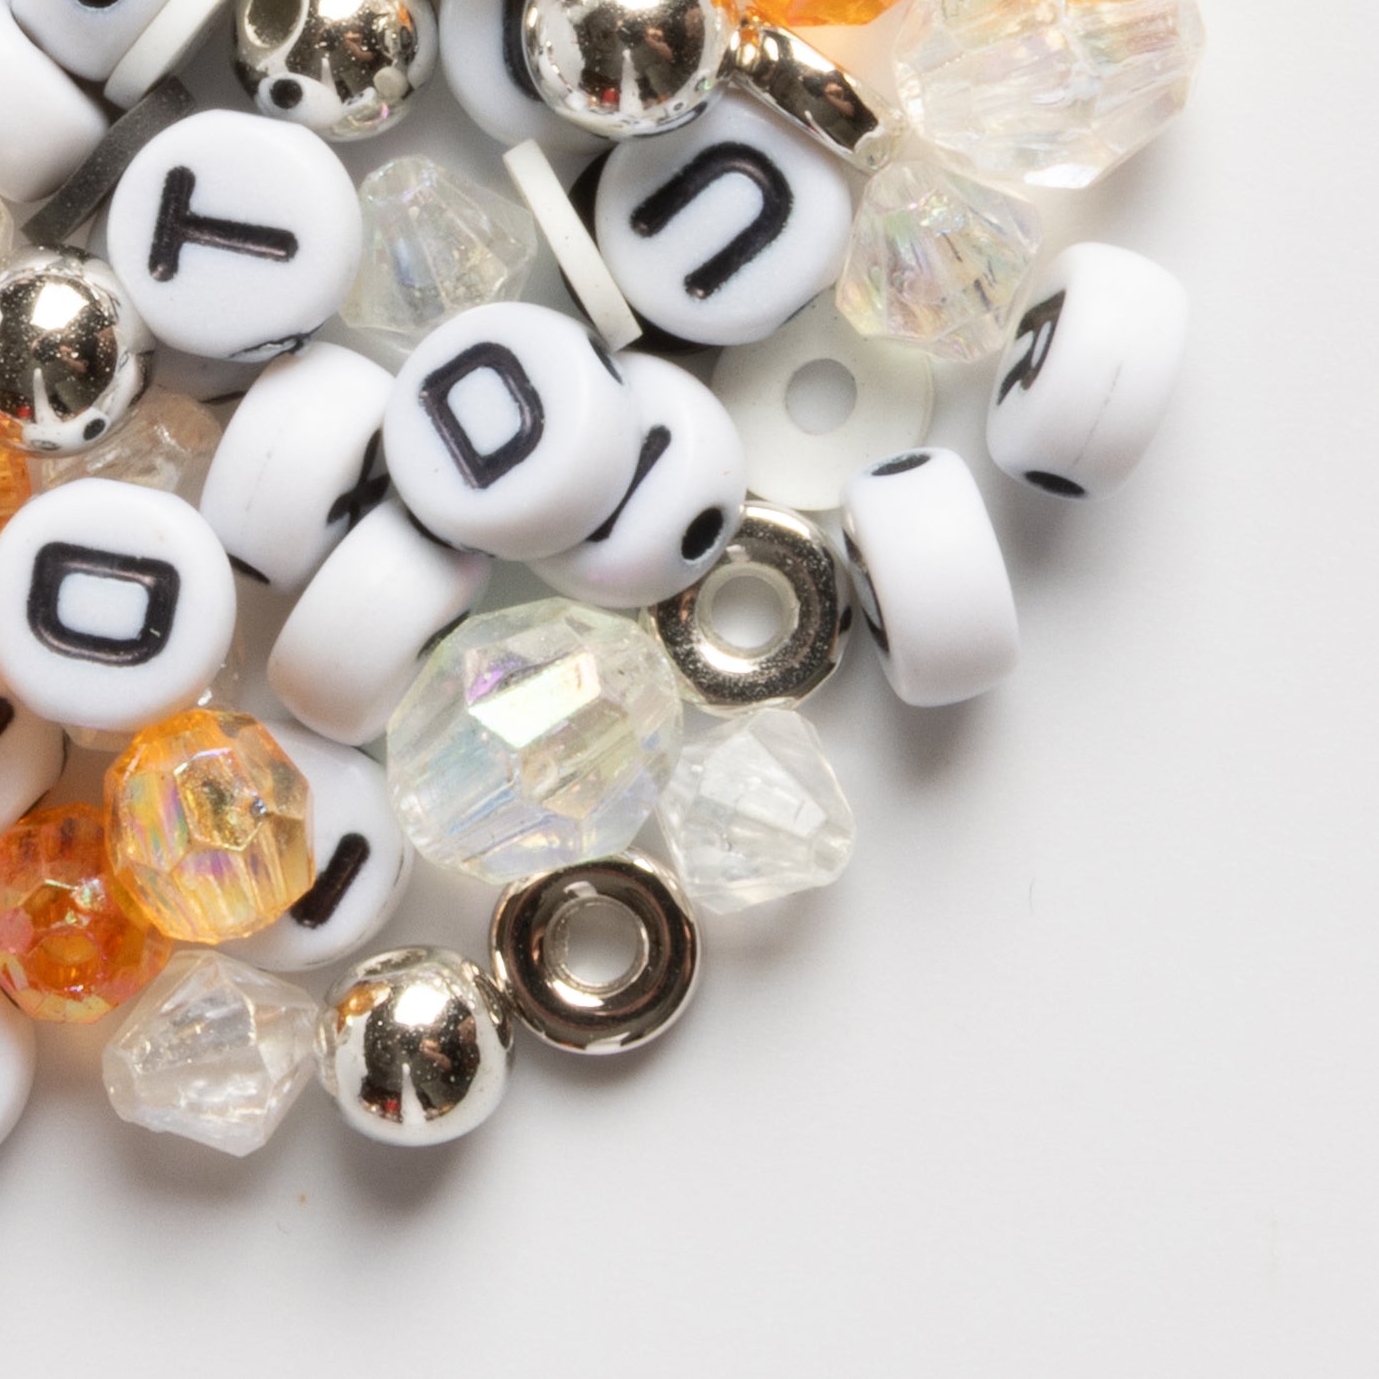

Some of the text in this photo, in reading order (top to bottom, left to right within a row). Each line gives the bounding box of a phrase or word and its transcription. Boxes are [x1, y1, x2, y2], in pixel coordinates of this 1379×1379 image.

[148, 166, 299, 282] T
[629, 141, 794, 300] U
[420, 342, 545, 489] D
[26, 541, 181, 667] D
